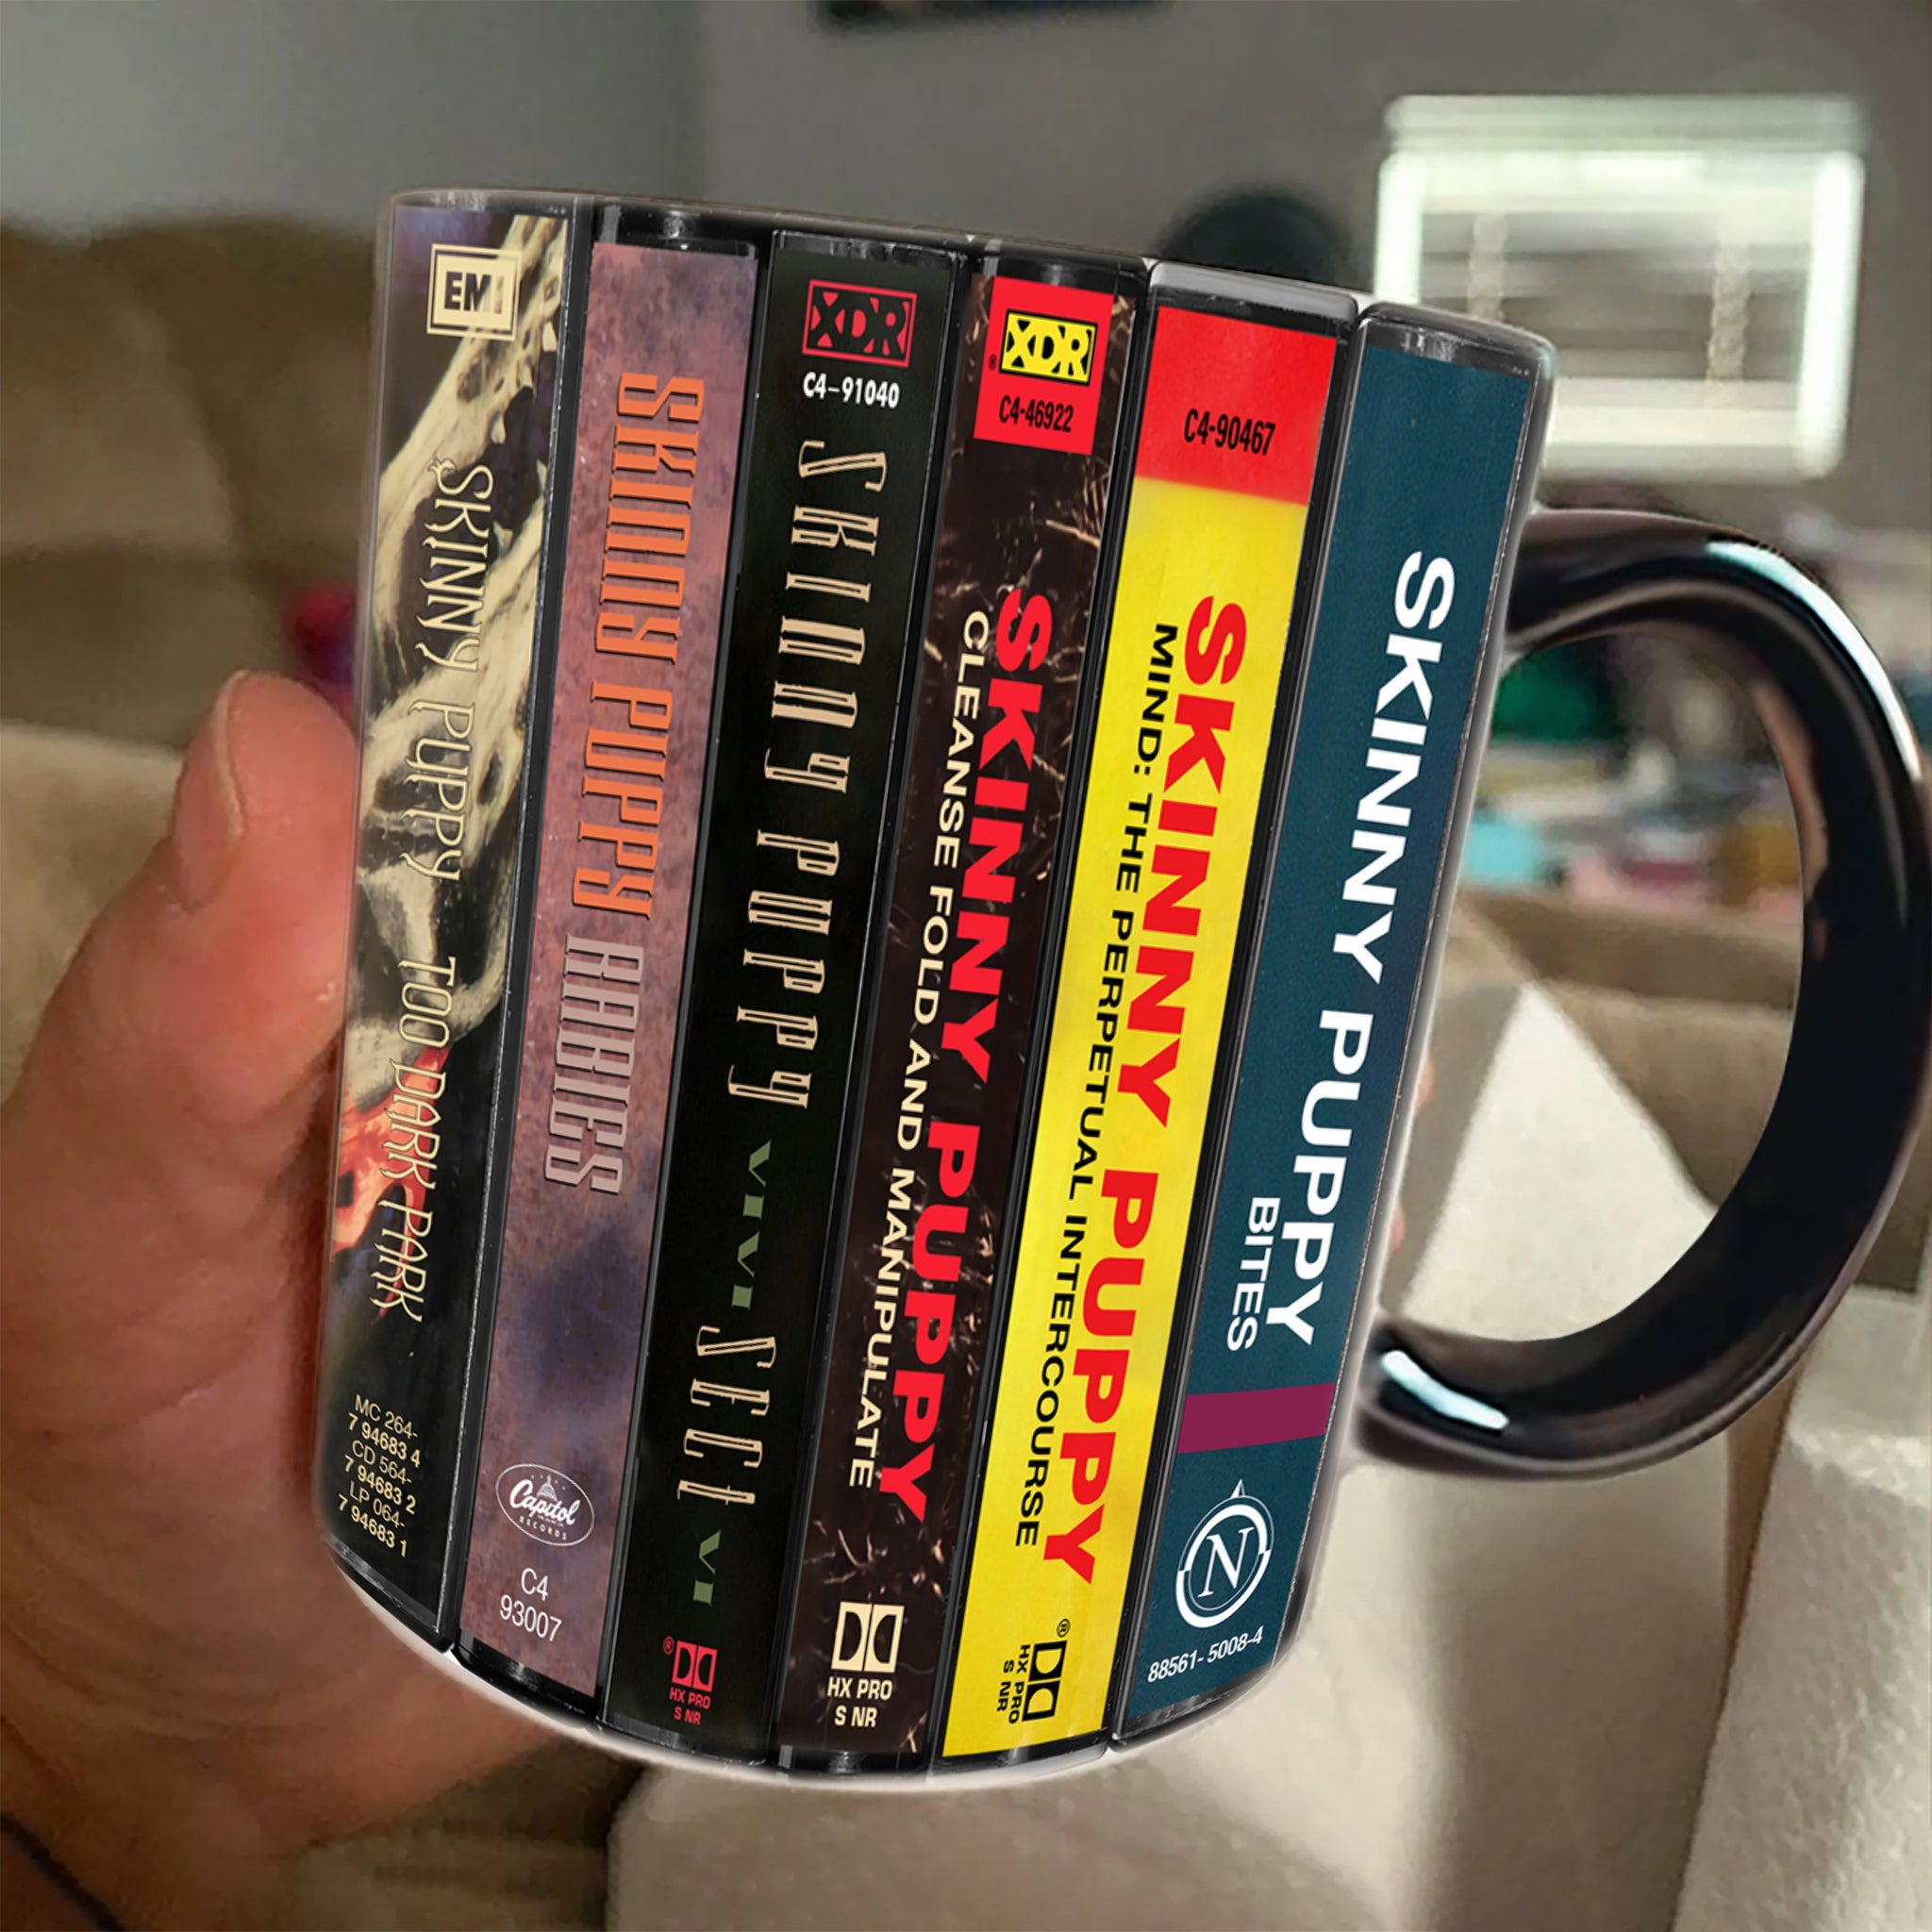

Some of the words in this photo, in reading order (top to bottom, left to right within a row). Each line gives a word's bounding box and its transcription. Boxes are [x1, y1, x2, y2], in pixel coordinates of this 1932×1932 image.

[443, 271, 504, 315] EMI
[807, 285, 913, 362] XDR
[1003, 315, 1094, 383] XDR
[803, 372, 900, 409] C4-91040
[999, 394, 1074, 433] C4-46922
[1184, 408, 1275, 456] C4-90467
[595, 372, 705, 665] SKINNY
[413, 457, 494, 673] SKINNY
[1134, 624, 1178, 775] MIND:
[933, 610, 990, 869] CLEANSE
[1333, 550, 1455, 985] SKINNY
[399, 699, 475, 881] PUPPY
[572, 679, 673, 921] PUPPY
[941, 588, 1052, 1084] SKINNY
[1116, 792, 1152, 893] THE
[1117, 595, 1246, 1128] SKINNY
[913, 885, 954, 1025] FOLD
[397, 956, 457, 1048] TOO
[1069, 910, 1134, 1201] PERPETUAL
[378, 1058, 447, 1190] DARK
[896, 1040, 931, 1151] AND
[1265, 1009, 1374, 1345] PUPPY
[369, 1198, 433, 1323] PARK
[1226, 1197, 1281, 1351] BITES
[849, 1167, 916, 1488] MANIPULATE
[879, 1121, 981, 1523] PUPPY
[1016, 1215, 1088, 1547] INTERCOURSE
[1043, 1169, 1158, 1585] PUPPY
[348, 1411, 358, 1431] 7
[361, 1421, 407, 1460] 94683
[410, 1449, 421, 1468] 4
[355, 1393, 381, 1422] MC
[384, 1410, 418, 1440] 264-
[344, 1454, 355, 1473] 7
[358, 1464, 402, 1505] 94683
[406, 1494, 416, 1515] 2
[352, 1440, 375, 1465] CD
[378, 1456, 411, 1485] 564-
[339, 1493, 348, 1511] 7
[351, 1505, 395, 1549] 94683
[400, 1540, 407, 1557] 1
[350, 1480, 370, 1504] LP
[373, 1497, 406, 1528] 064-
[509, 1479, 581, 1525] Capitol
[519, 1515, 567, 1541] RECORDS
[521, 1567, 549, 1601] C4
[1197, 1527, 1255, 1597] N
[499, 1594, 562, 1641] 93007
[827, 1676, 852, 1698] HX
[856, 1679, 893, 1701] PRO
[1003, 1660, 1015, 1674] S
[1016, 1644, 1031, 1674] HX
[669, 1687, 686, 1704] HX
[688, 1691, 711, 1719] PRO
[674, 1706, 682, 1721] S
[684, 1708, 702, 1725] NR
[835, 1706, 846, 1725] S
[851, 1707, 878, 1728] NR
[996, 1681, 1011, 1712] NR
[1008, 1681, 1024, 1724] PRO
